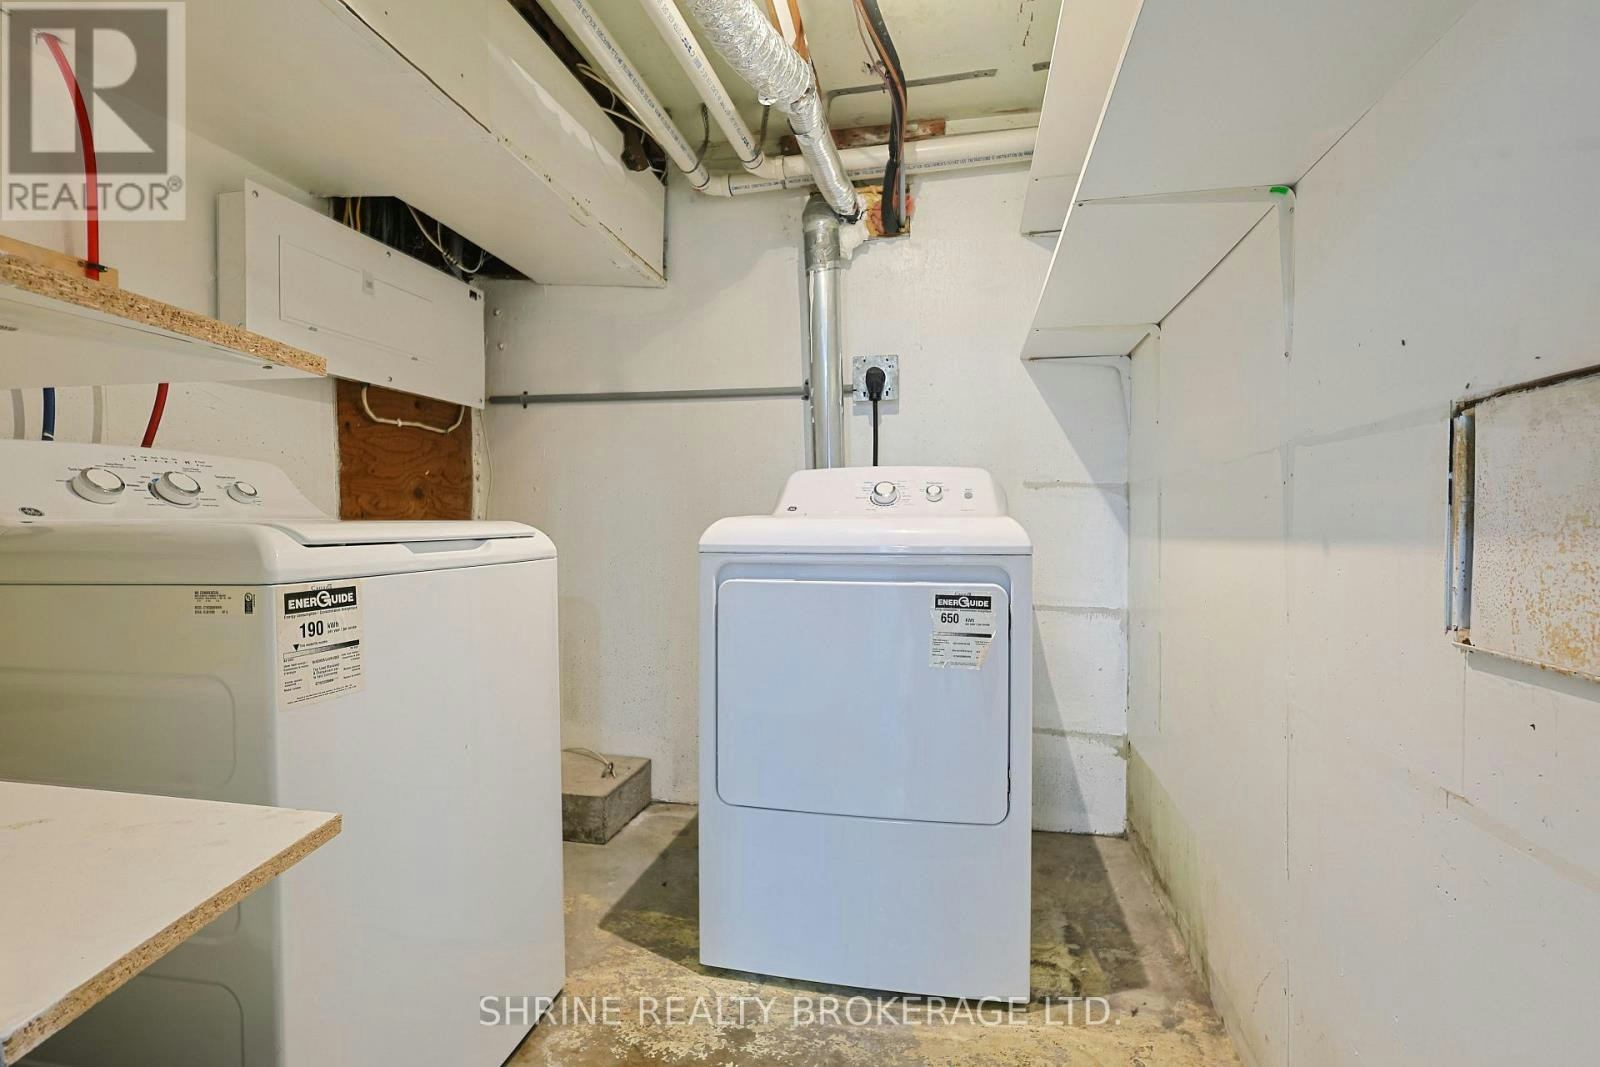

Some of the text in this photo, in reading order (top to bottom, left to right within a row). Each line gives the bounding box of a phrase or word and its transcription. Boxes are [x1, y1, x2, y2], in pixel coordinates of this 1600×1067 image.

[288, 590, 354, 609] ENERGUIDE
[937, 597, 990, 607] ENERGUIDE
[941, 613, 960, 624] 650
[299, 620, 324, 638] 190
